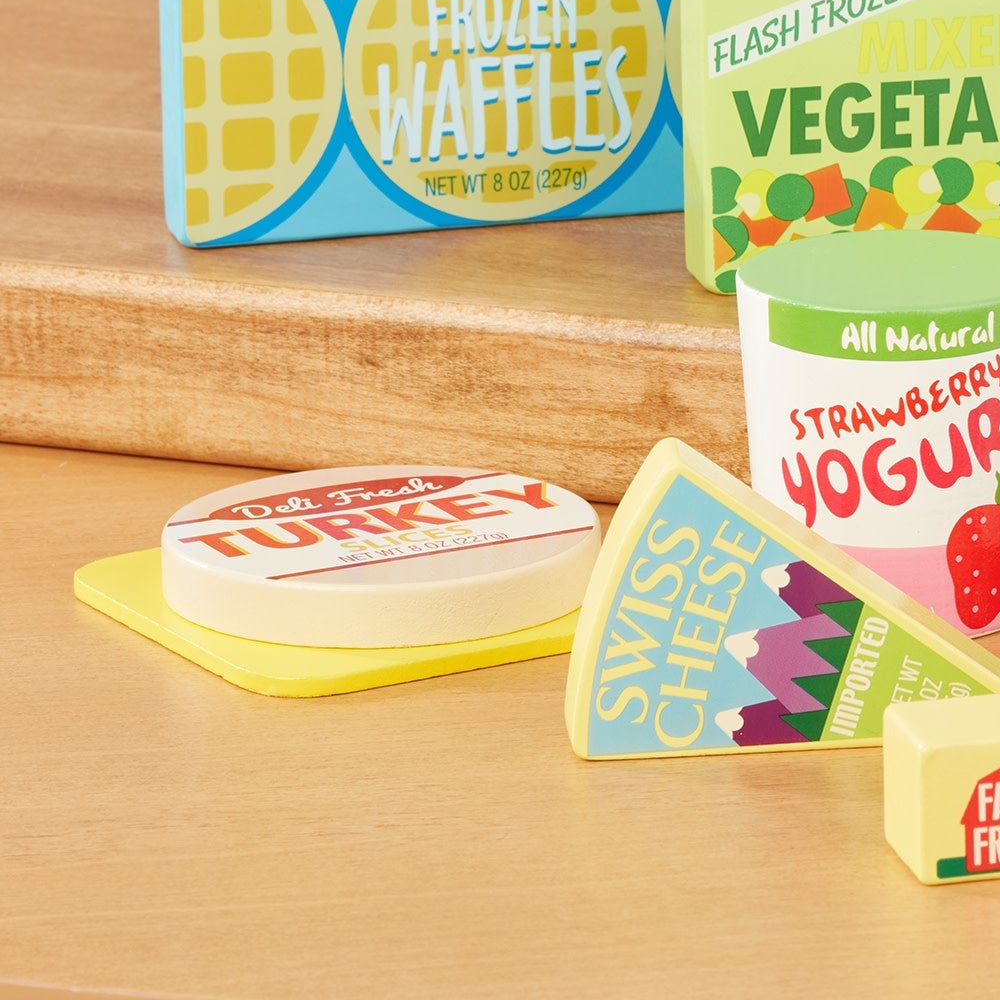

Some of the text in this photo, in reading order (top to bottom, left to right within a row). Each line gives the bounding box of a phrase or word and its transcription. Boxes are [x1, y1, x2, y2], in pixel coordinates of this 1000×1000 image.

[712, 9, 801, 73] FLASH
[376, 45, 633, 165] WAFFLES
[425, 167, 588, 196] NET WT 8 OZ (227g)
[841, 310, 994, 353] All Natural
[178, 482, 560, 559] TURKEY
[231, 478, 443, 520] Deli Fresh
[338, 532, 509, 564] NET WT 8 OZ (227g)
[340, 524, 473, 553] SLICES
[595, 518, 701, 725] SWISS
[654, 519, 768, 749] CHEESE
[829, 615, 890, 737] IMPORTED
[891, 655, 923, 703] ET WT
[920, 677, 943, 701] OZ
